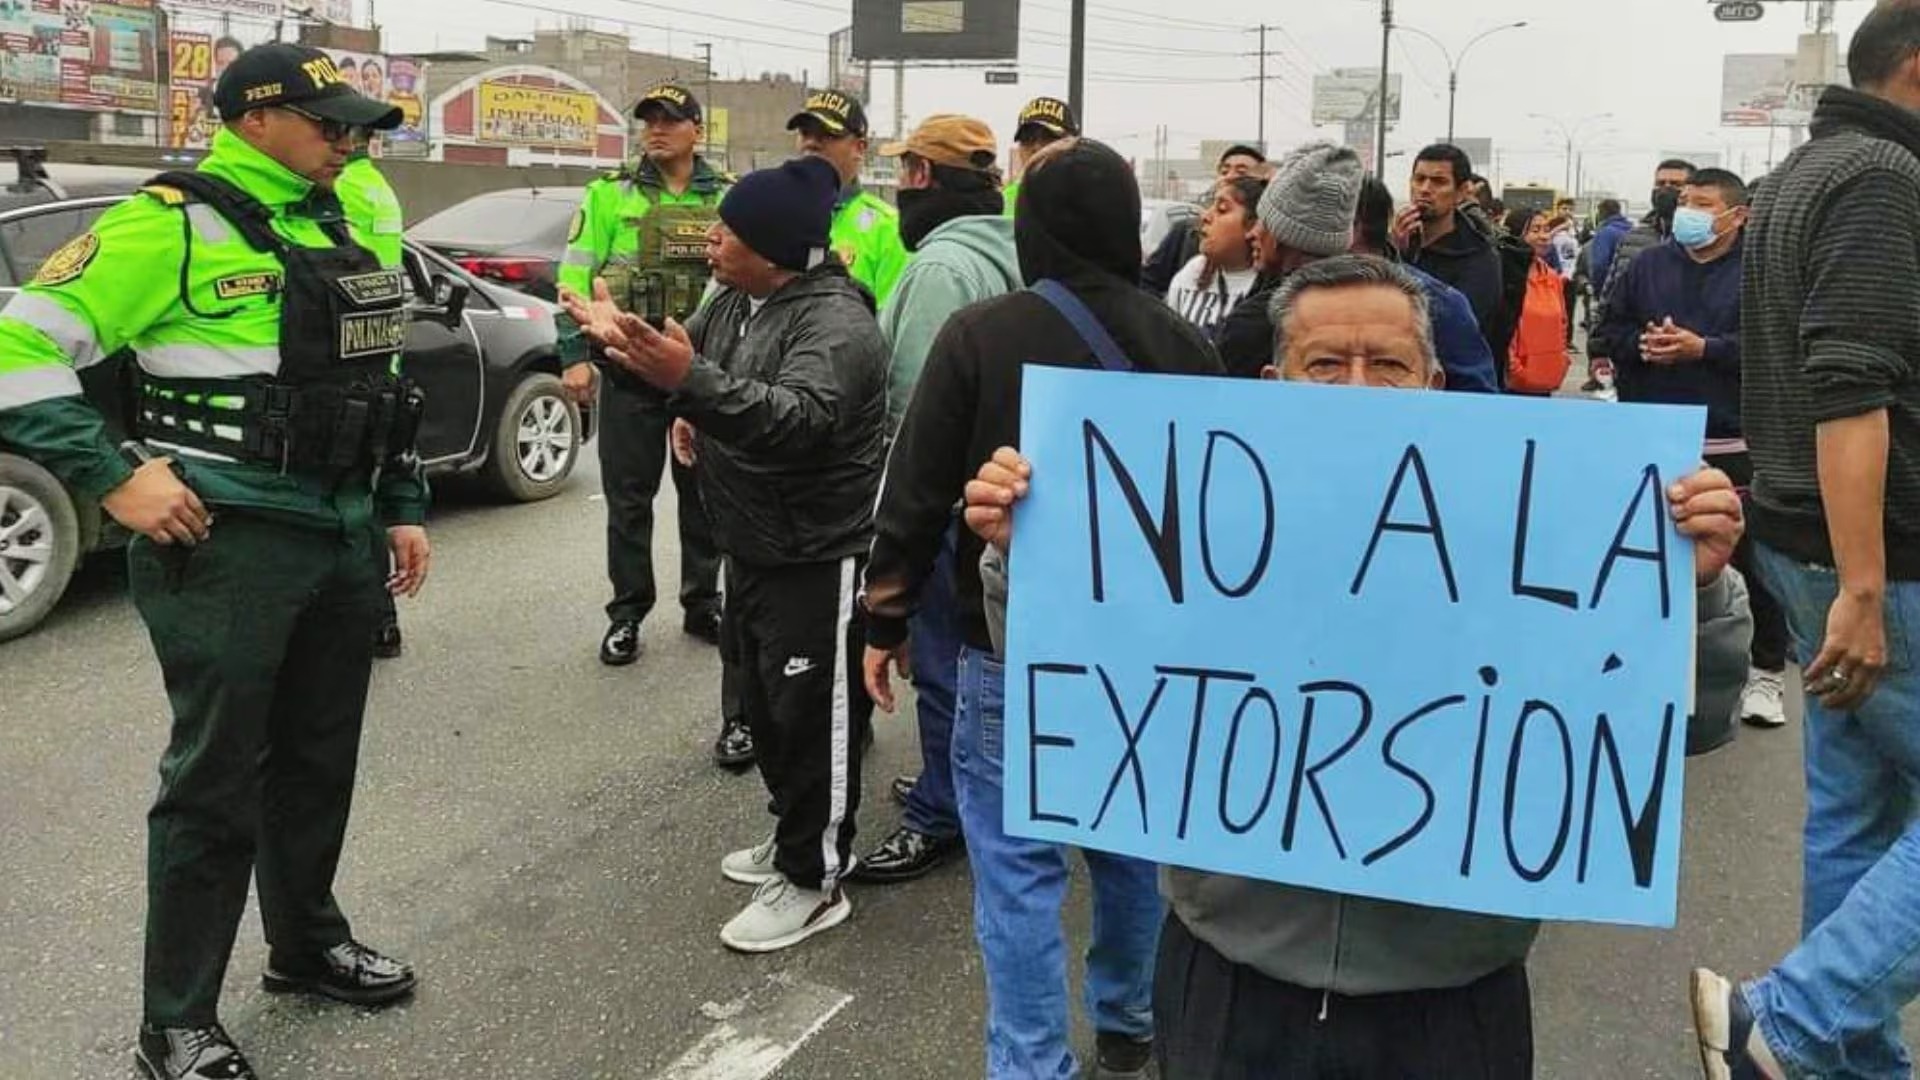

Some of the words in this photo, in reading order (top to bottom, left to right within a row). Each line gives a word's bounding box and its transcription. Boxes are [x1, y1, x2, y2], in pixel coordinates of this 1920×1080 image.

[173, 42, 209, 79] 28
[1082, 418, 1275, 605] NO
[1349, 443, 1459, 604] A
[1511, 438, 1671, 619] LA
